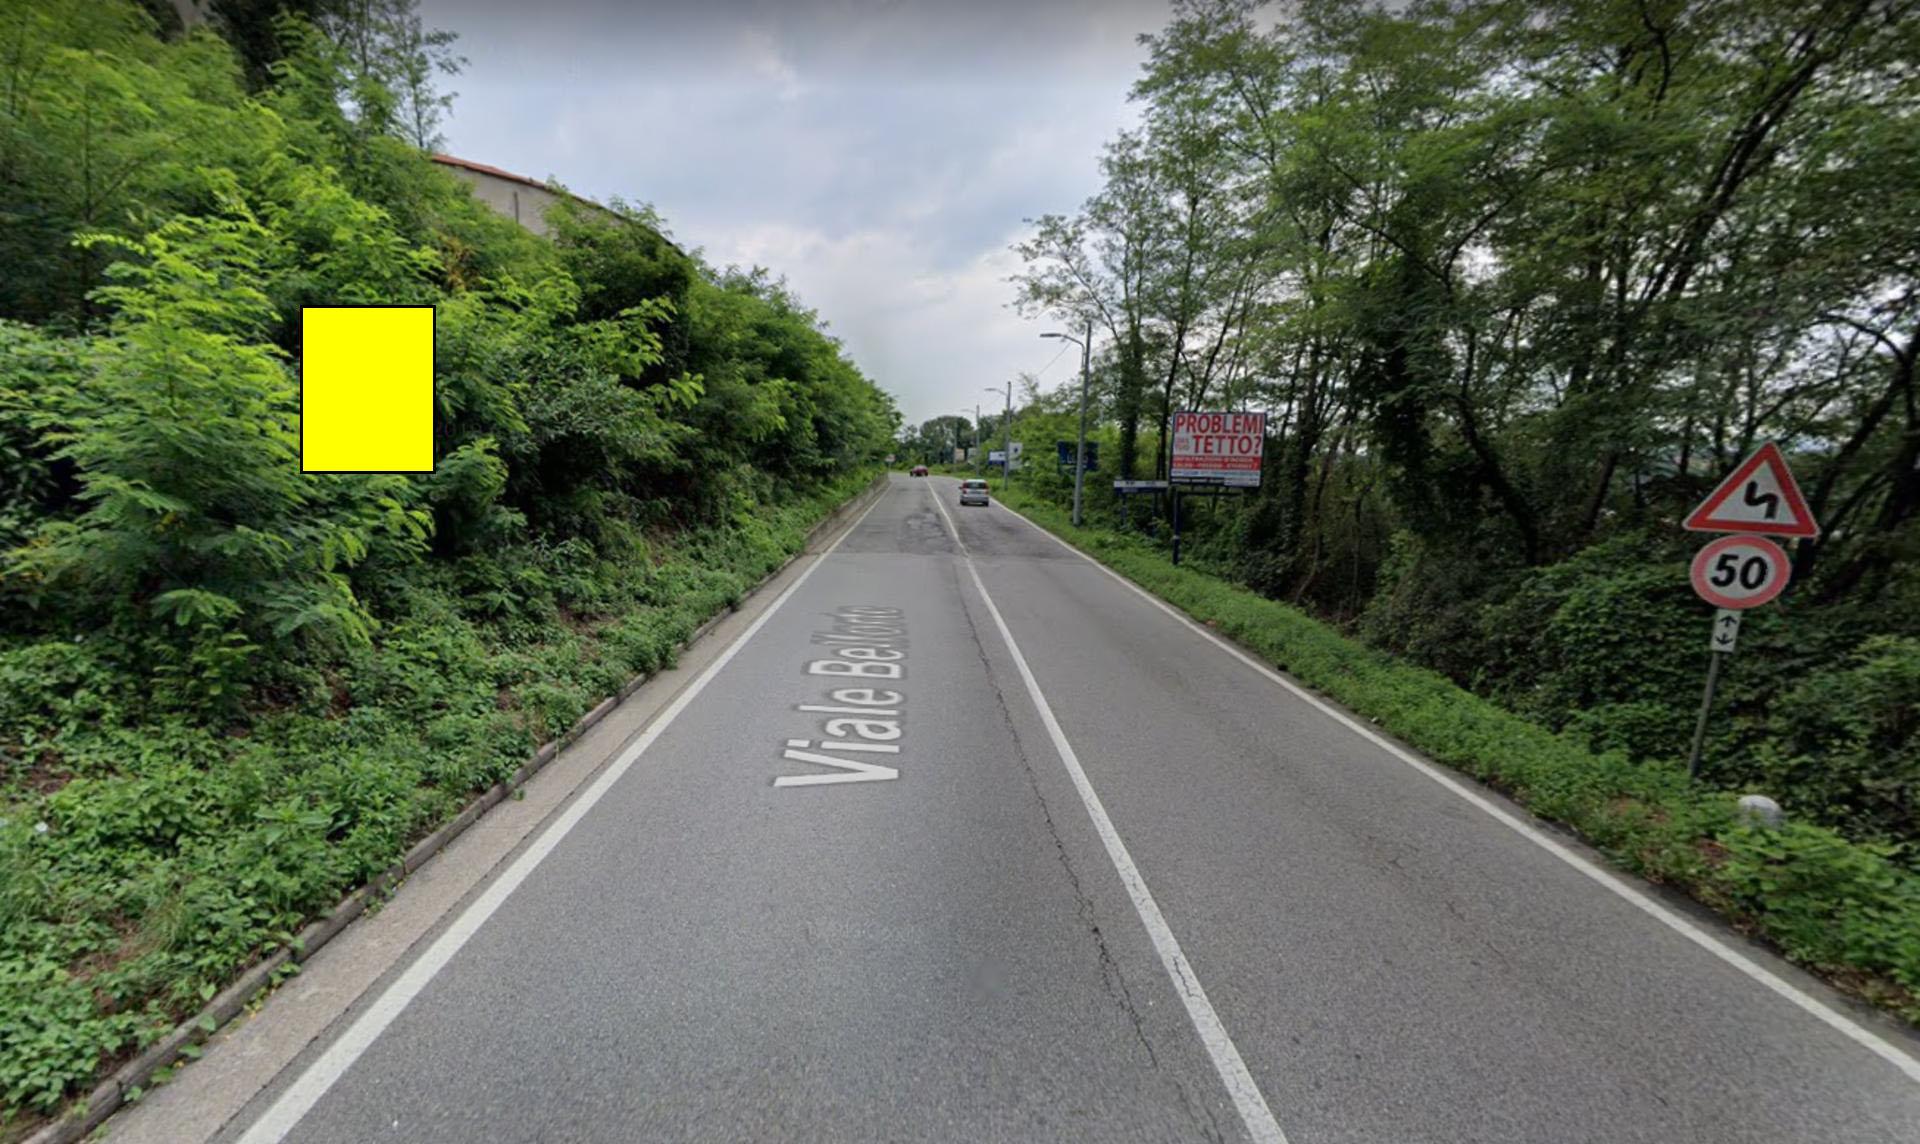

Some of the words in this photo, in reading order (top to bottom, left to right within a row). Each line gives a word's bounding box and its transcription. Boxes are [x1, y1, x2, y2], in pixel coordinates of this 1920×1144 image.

[1174, 413, 1264, 434] PROBLEMI
[1192, 434, 1262, 455] TETTO?
[1710, 553, 1769, 590] 50
